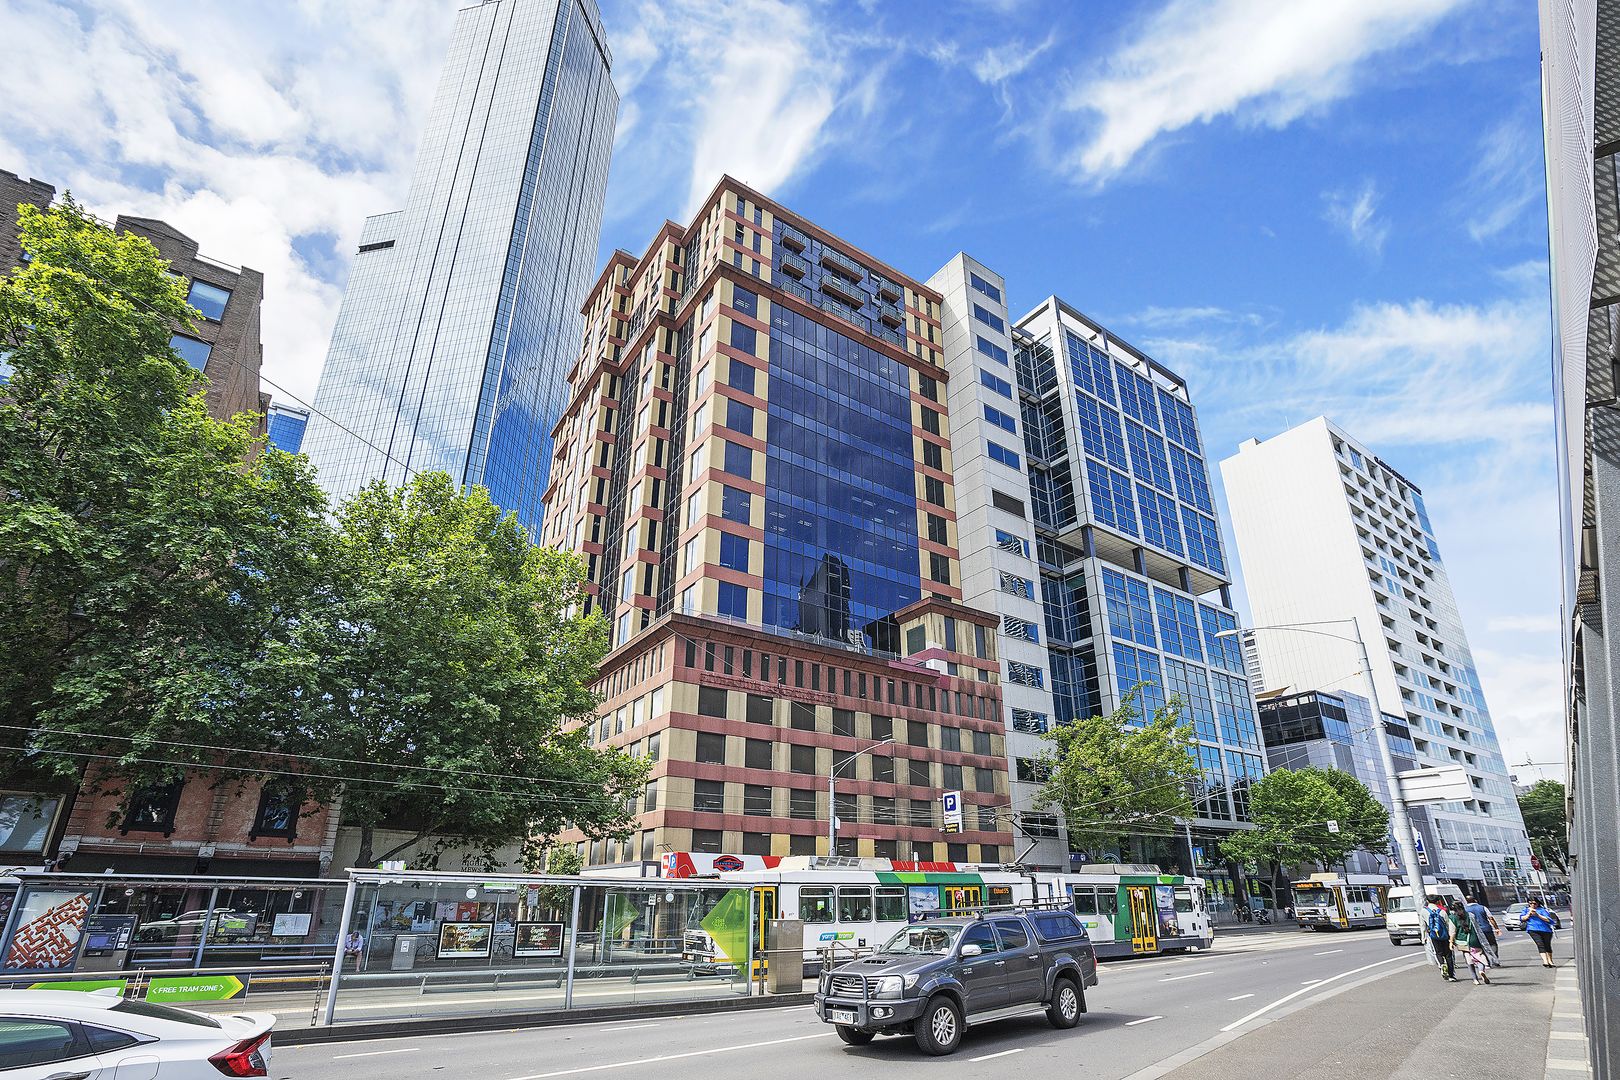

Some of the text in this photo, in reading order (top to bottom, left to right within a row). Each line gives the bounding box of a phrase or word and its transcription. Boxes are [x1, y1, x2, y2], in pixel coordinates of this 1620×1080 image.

[158, 984, 218, 994] FREE TRAM ZONE
